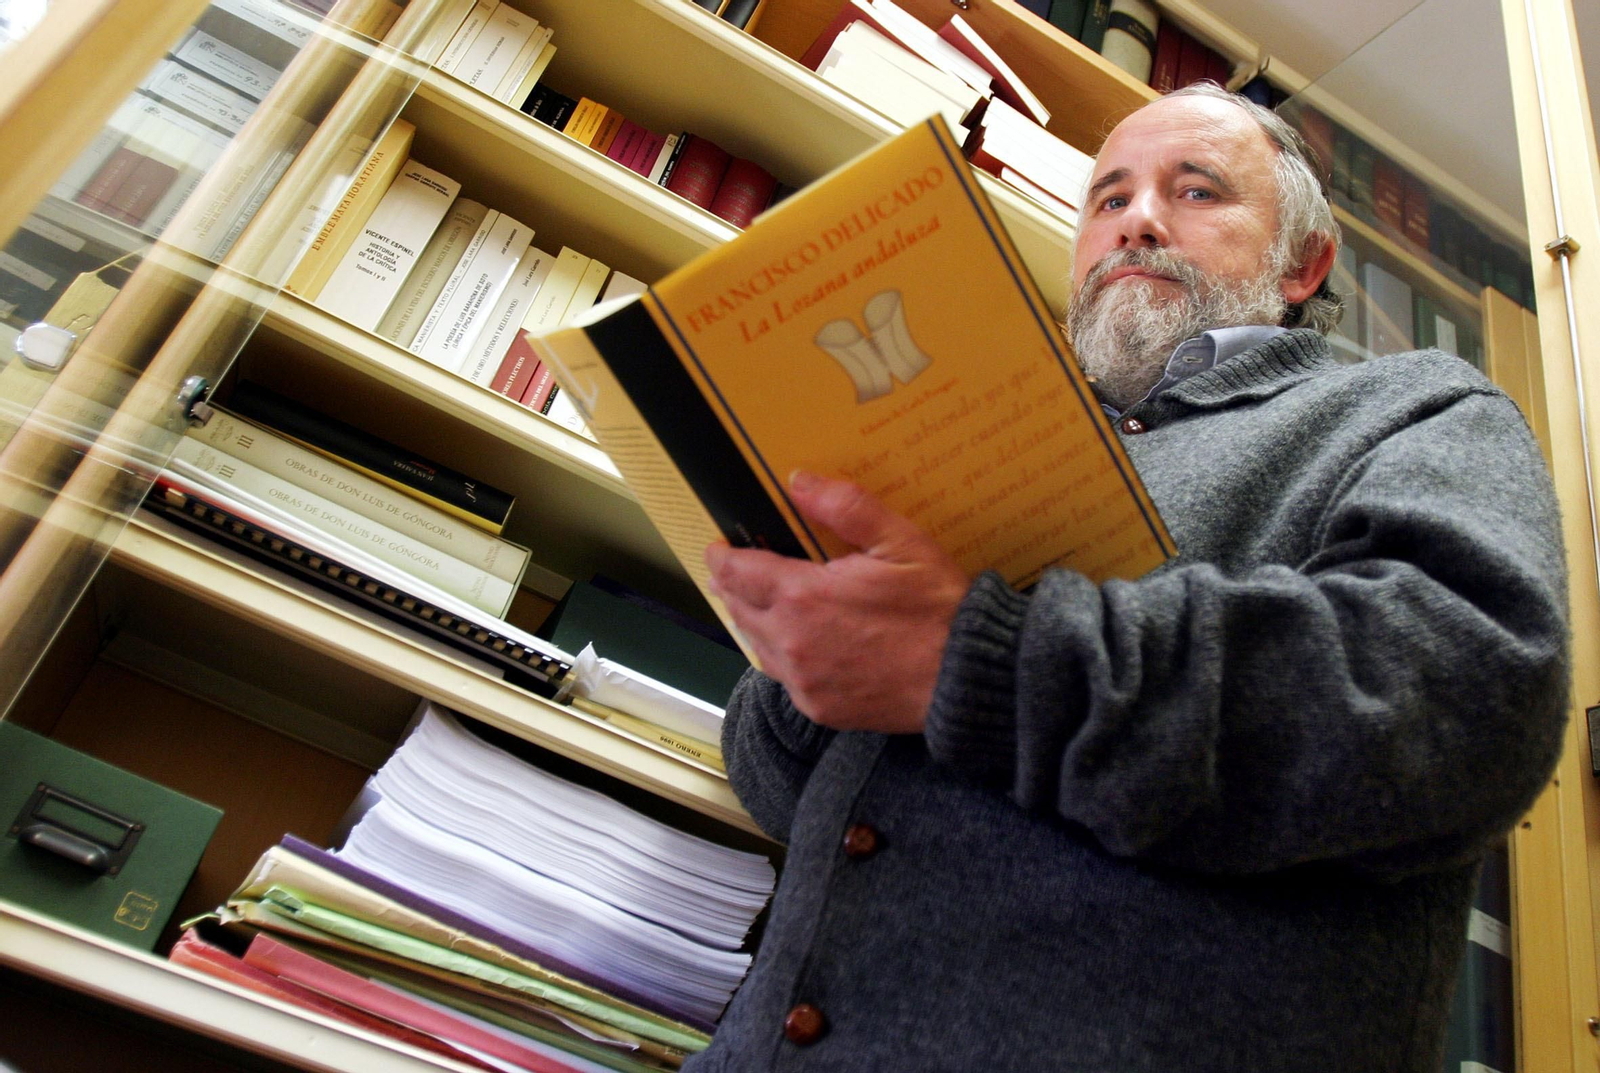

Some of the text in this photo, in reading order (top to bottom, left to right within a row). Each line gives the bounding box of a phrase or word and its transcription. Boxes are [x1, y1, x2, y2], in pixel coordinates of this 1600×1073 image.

[311, 149, 384, 251] EMBLEMATA HORATIANA
[364, 228, 415, 256] VICENTE ESPINEL
[368, 240, 394, 258] HISTORIA
[686, 242, 821, 334] FRANCISCO
[820, 166, 944, 251] DELICADO
[365, 245, 396, 266] ANTOLOGÍA
[374, 257, 397, 273] CRÍTICA
[355, 263, 373, 275] Tomos
[739, 214, 940, 344] La Lozana andaluza
[416, 314, 437, 343] MANIERISTA
[436, 291, 449, 308] TEXTO
[445, 274, 460, 293] PLURAL
[444, 326, 457, 343] POESÍA
[457, 311, 466, 322] LUIS
[462, 289, 478, 312] BARAHONA
[478, 272, 488, 284] SOTO
[469, 308, 477, 317] DEL
[472, 370, 480, 378] DE
[476, 358, 486, 370] ORO
[507, 355, 526, 381] PLECTROS
[392, 460, 434, 481] JUAN VALERA
[284, 457, 454, 540] OBRAS DE DON LUIS DE GÓNGORA
[267, 486, 440, 571] OBRAS DE DON LUIS DE GÓNGORA
[676, 743, 701, 758] ENERO
